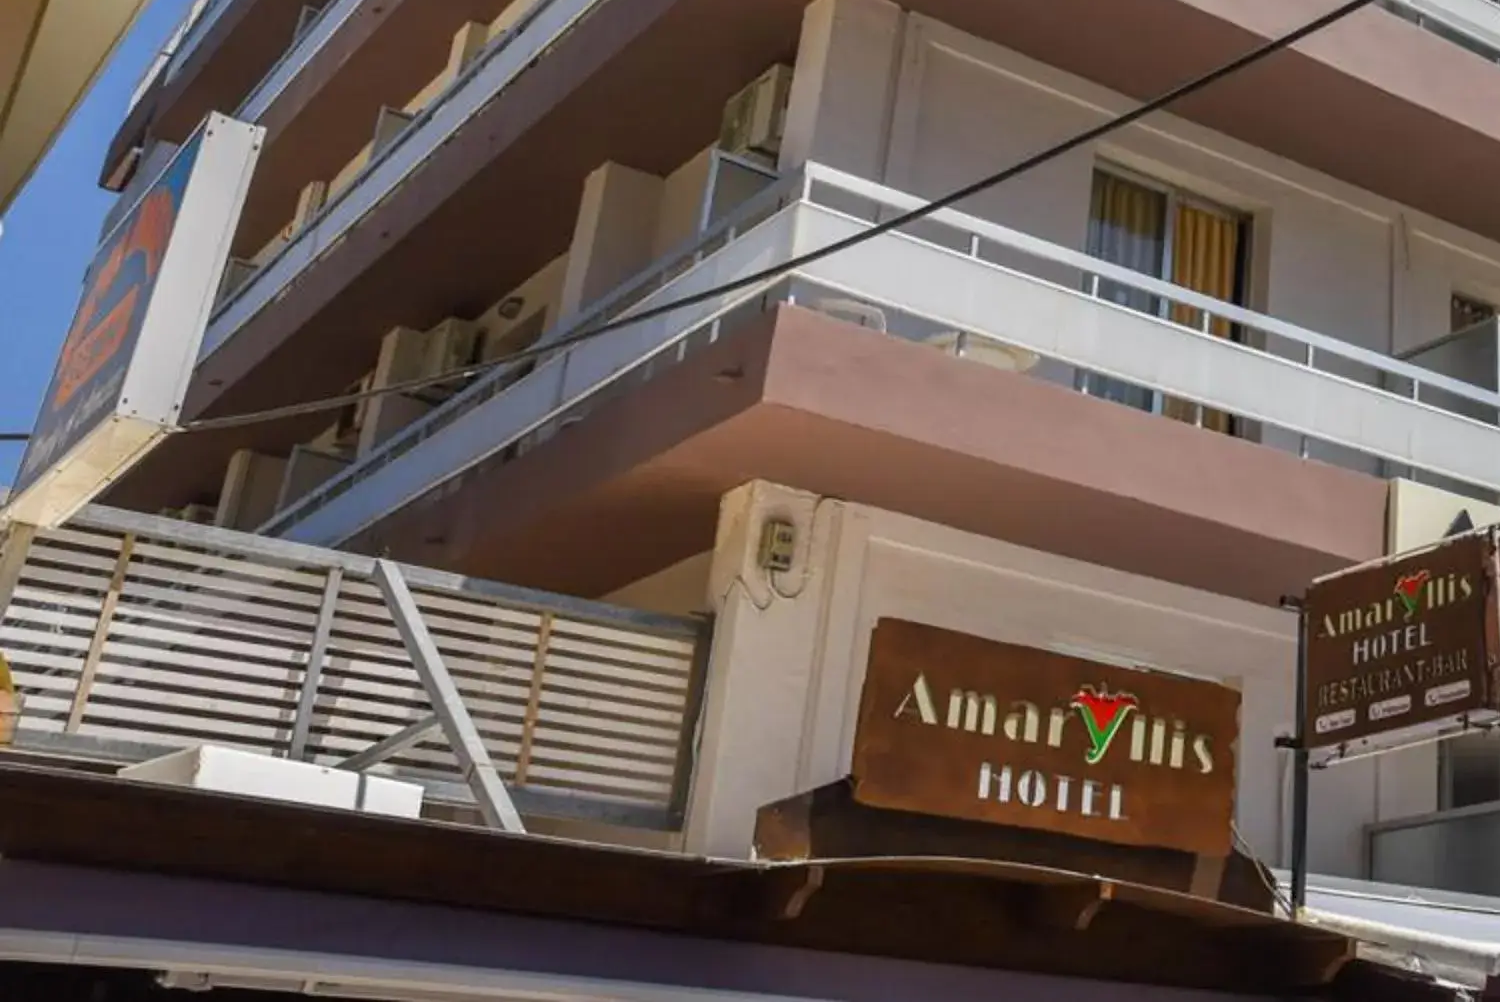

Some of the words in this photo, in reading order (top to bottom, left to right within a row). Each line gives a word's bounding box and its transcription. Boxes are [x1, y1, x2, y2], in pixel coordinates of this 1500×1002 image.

[1316, 569, 1473, 637] Amaryllis
[1353, 622, 1434, 665] HOTEL
[893, 669, 1214, 774] Amaryllis
[977, 761, 1129, 820] HOTEL
